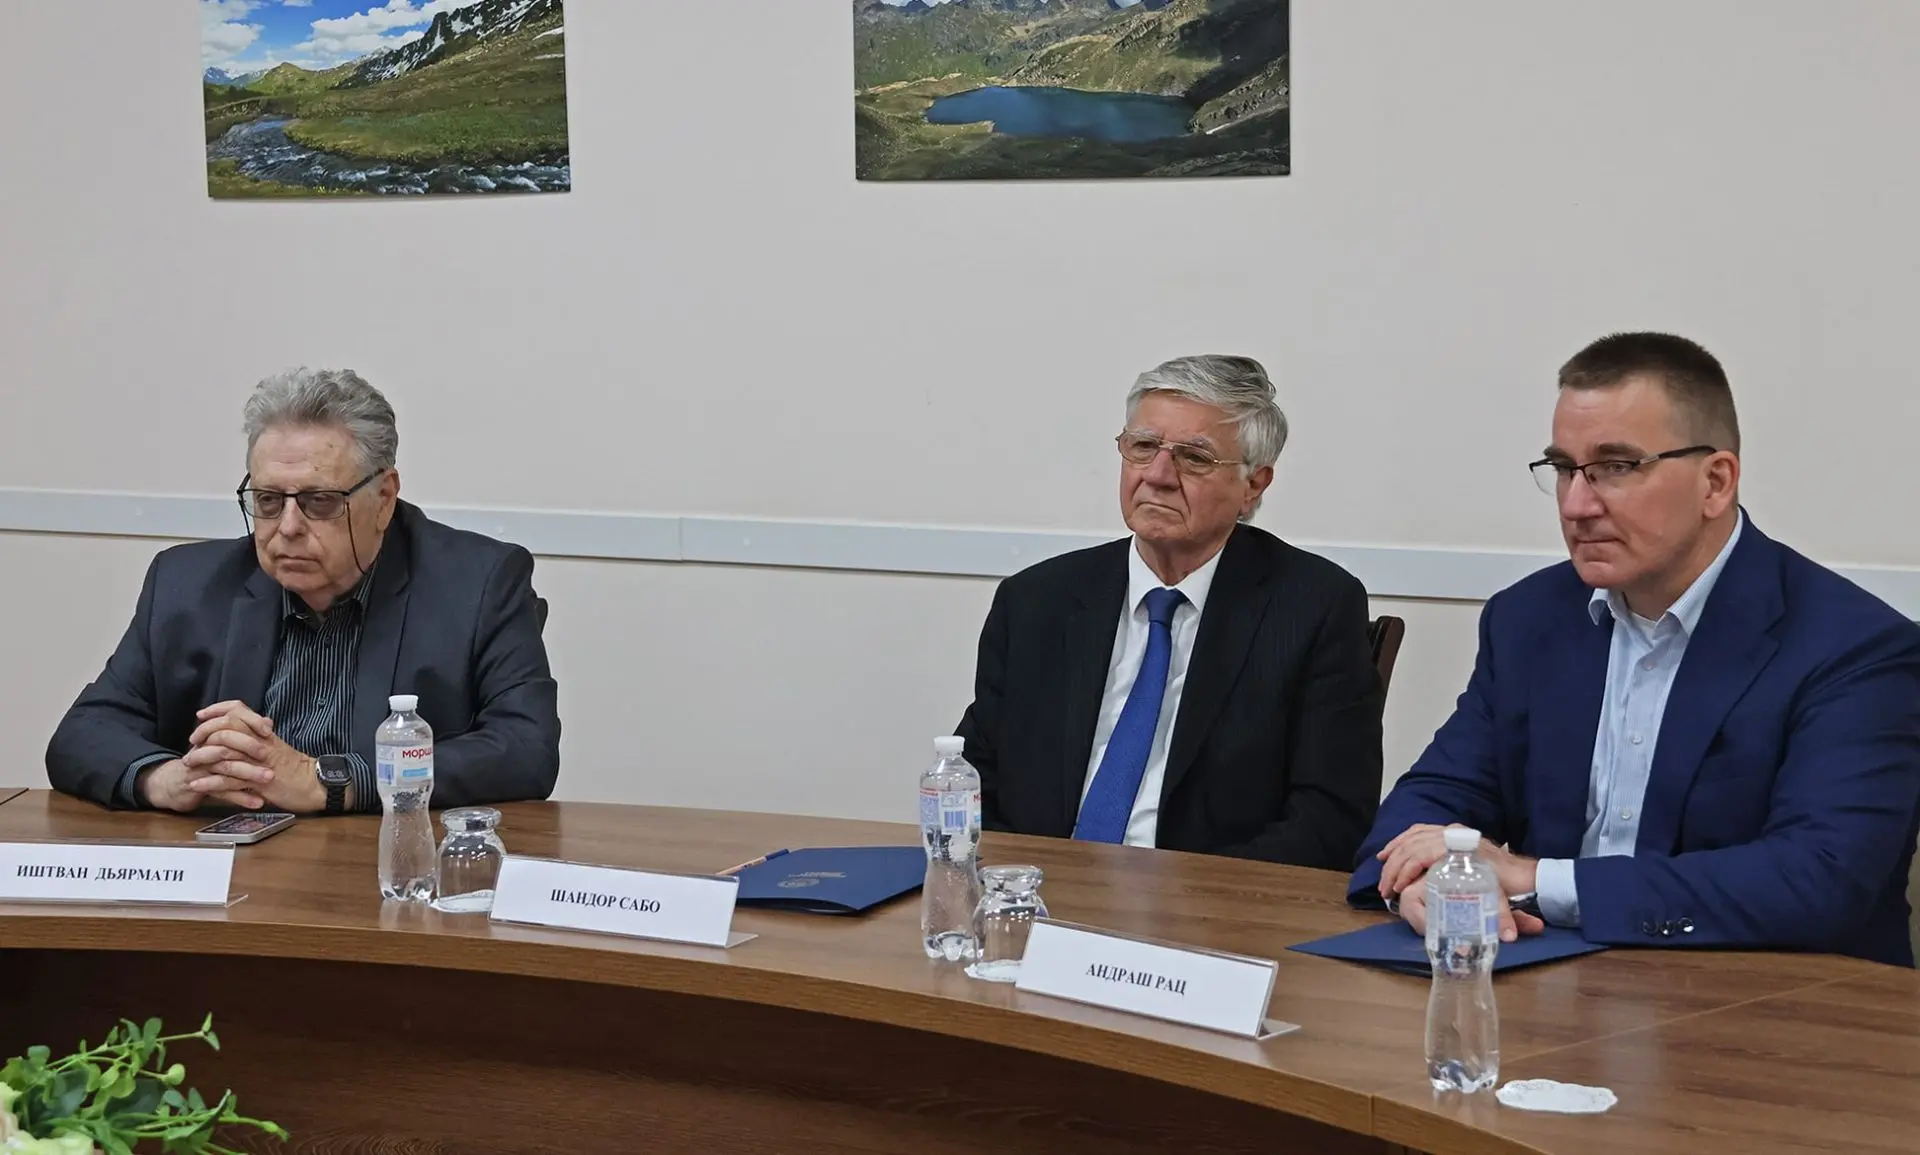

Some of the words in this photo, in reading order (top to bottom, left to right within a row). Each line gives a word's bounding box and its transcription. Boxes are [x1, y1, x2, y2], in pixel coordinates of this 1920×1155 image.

[16, 864, 88, 879] ИШТВАН
[94, 867, 185, 882] ДЬЯРМАТИ
[550, 888, 617, 908] ШАНДОР
[619, 896, 661, 914] САБО
[1085, 963, 1153, 987] АНДРАШ
[1155, 975, 1187, 996] РАЦ
